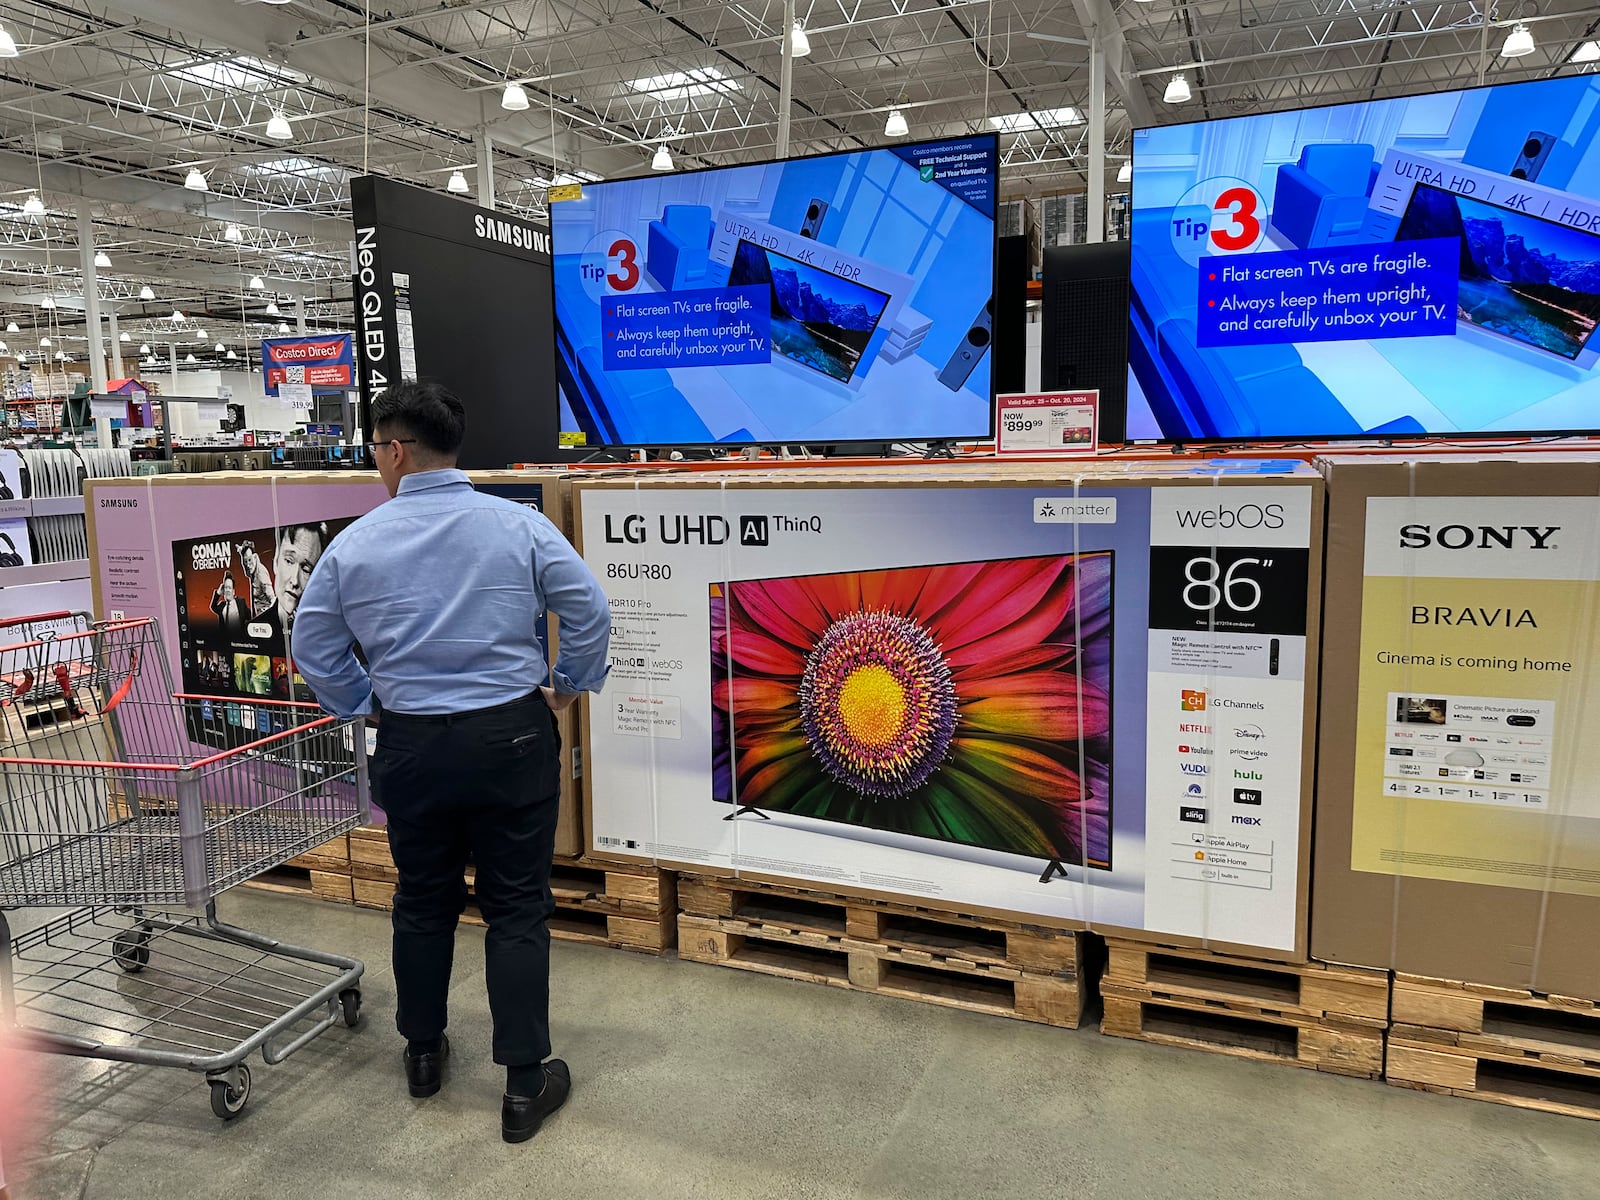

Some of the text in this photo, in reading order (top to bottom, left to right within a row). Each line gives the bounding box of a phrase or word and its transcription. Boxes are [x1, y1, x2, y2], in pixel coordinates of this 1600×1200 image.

[930, 146, 953, 154] members
[936, 154, 962, 163] Technical
[963, 152, 987, 160] Support
[960, 168, 986, 176] Warranty
[1395, 159, 1600, 232] ULTRA HD 4K HDR
[1172, 187, 1260, 251] Tip 3
[356, 226, 377, 286] Neo
[724, 220, 862, 281] ULTRA HD 4K HDR
[581, 239, 640, 291] Tip 3
[1222, 252, 1431, 282] Flat screen TVs are fragile.
[1219, 283, 1431, 312] Always keep them upright,
[616, 296, 752, 318] Flat screen TVs are fragile.
[1218, 304, 1446, 333] and carefully unbox your TV.
[362, 292, 385, 362] QLED
[616, 321, 754, 344] Always keep them upright,
[276, 346, 337, 359] Costco Direct
[616, 338, 765, 359] and carefully unbox your TV.
[101, 499, 138, 508] SAMSUNG
[1061, 505, 1110, 515] matter
[1176, 504, 1284, 529] webOS
[605, 515, 822, 545] LG UHD AI ThinQ
[1400, 525, 1561, 549] SONY
[192, 541, 231, 560] CONAN
[607, 563, 672, 580] 86UR80
[608, 599, 652, 608] HDR10 Pro
[1412, 606, 1538, 628] BRAVIA
[610, 656, 636, 666] ThinQ
[652, 660, 682, 670] webOS
[1377, 652, 1572, 672] Cinema is coming home
[618, 704, 624, 712] 3
[1188, 697, 1202, 705] CH
[1224, 699, 1264, 710] Channels
[1180, 724, 1212, 734] NETFLIX
[1191, 746, 1213, 754] YouTube
[1234, 769, 1262, 780] hulu
[1414, 786, 1421, 794] 2
[1468, 790, 1472, 798] 1
[1523, 794, 1528, 802] 1
[1186, 811, 1261, 826] sling max
[1226, 840, 1250, 849] AirPlay
